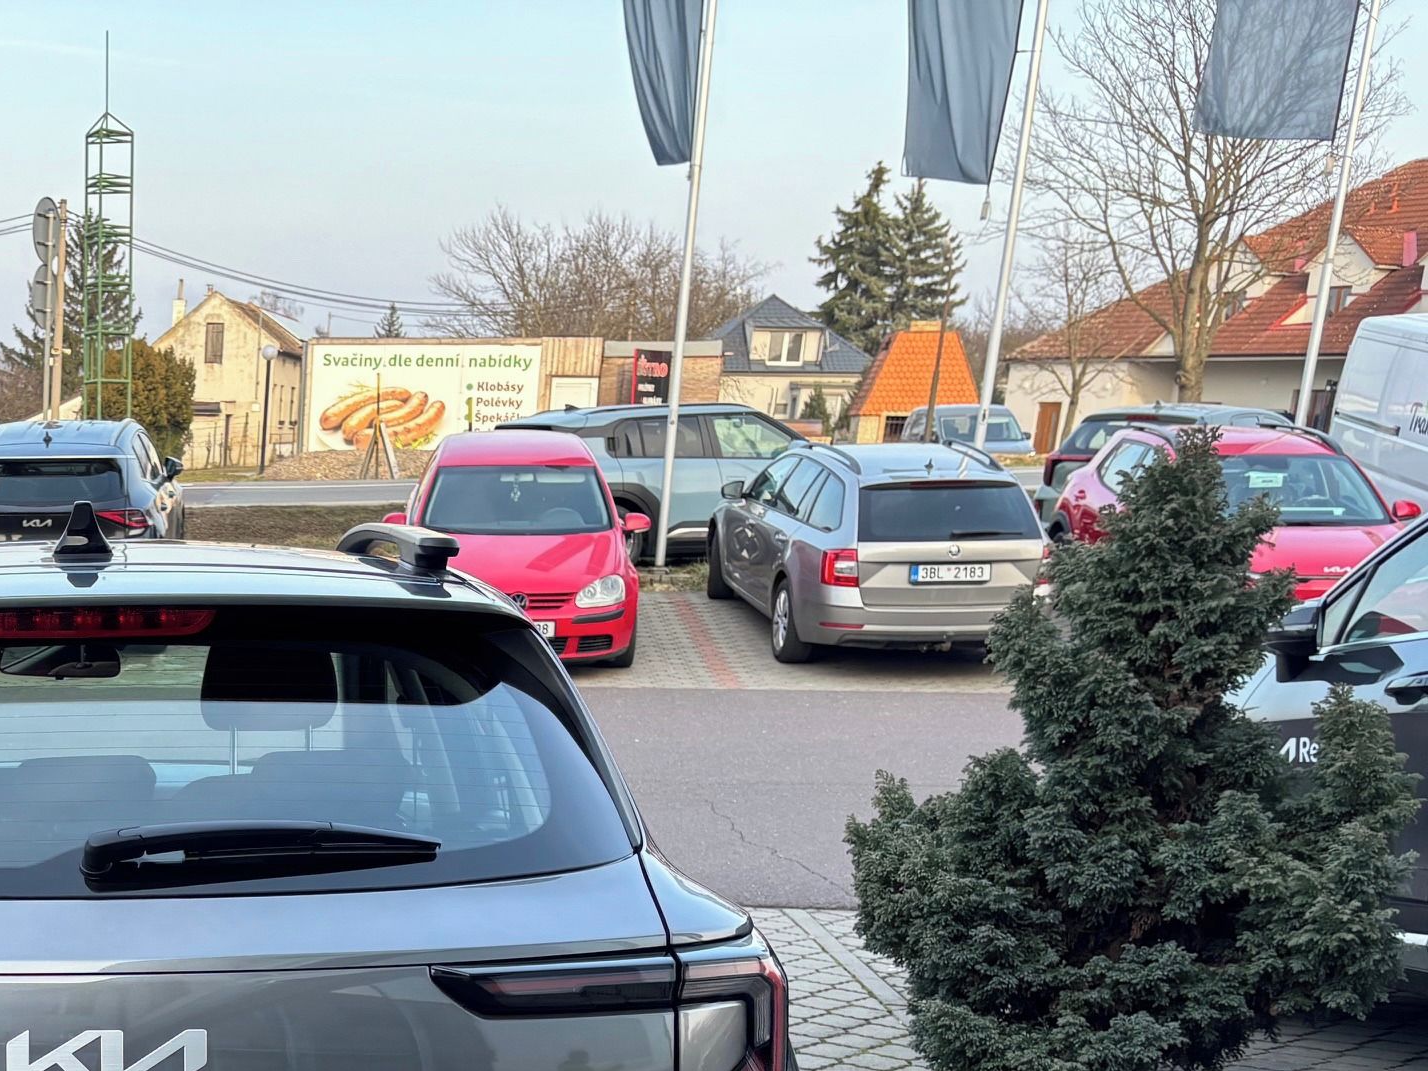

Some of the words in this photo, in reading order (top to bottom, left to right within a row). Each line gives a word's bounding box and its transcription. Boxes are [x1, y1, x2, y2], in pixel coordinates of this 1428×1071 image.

[323, 353, 383, 370] Svačiny
[388, 354, 412, 367] dle
[416, 354, 460, 368] denní
[468, 354, 532, 371] nabídky
[476, 381, 524, 395] Klobásy
[476, 397, 523, 410] Polévky
[22, 518, 53, 528] KIA
[921, 567, 943, 579] 3BL
[954, 566, 984, 579] 2183
